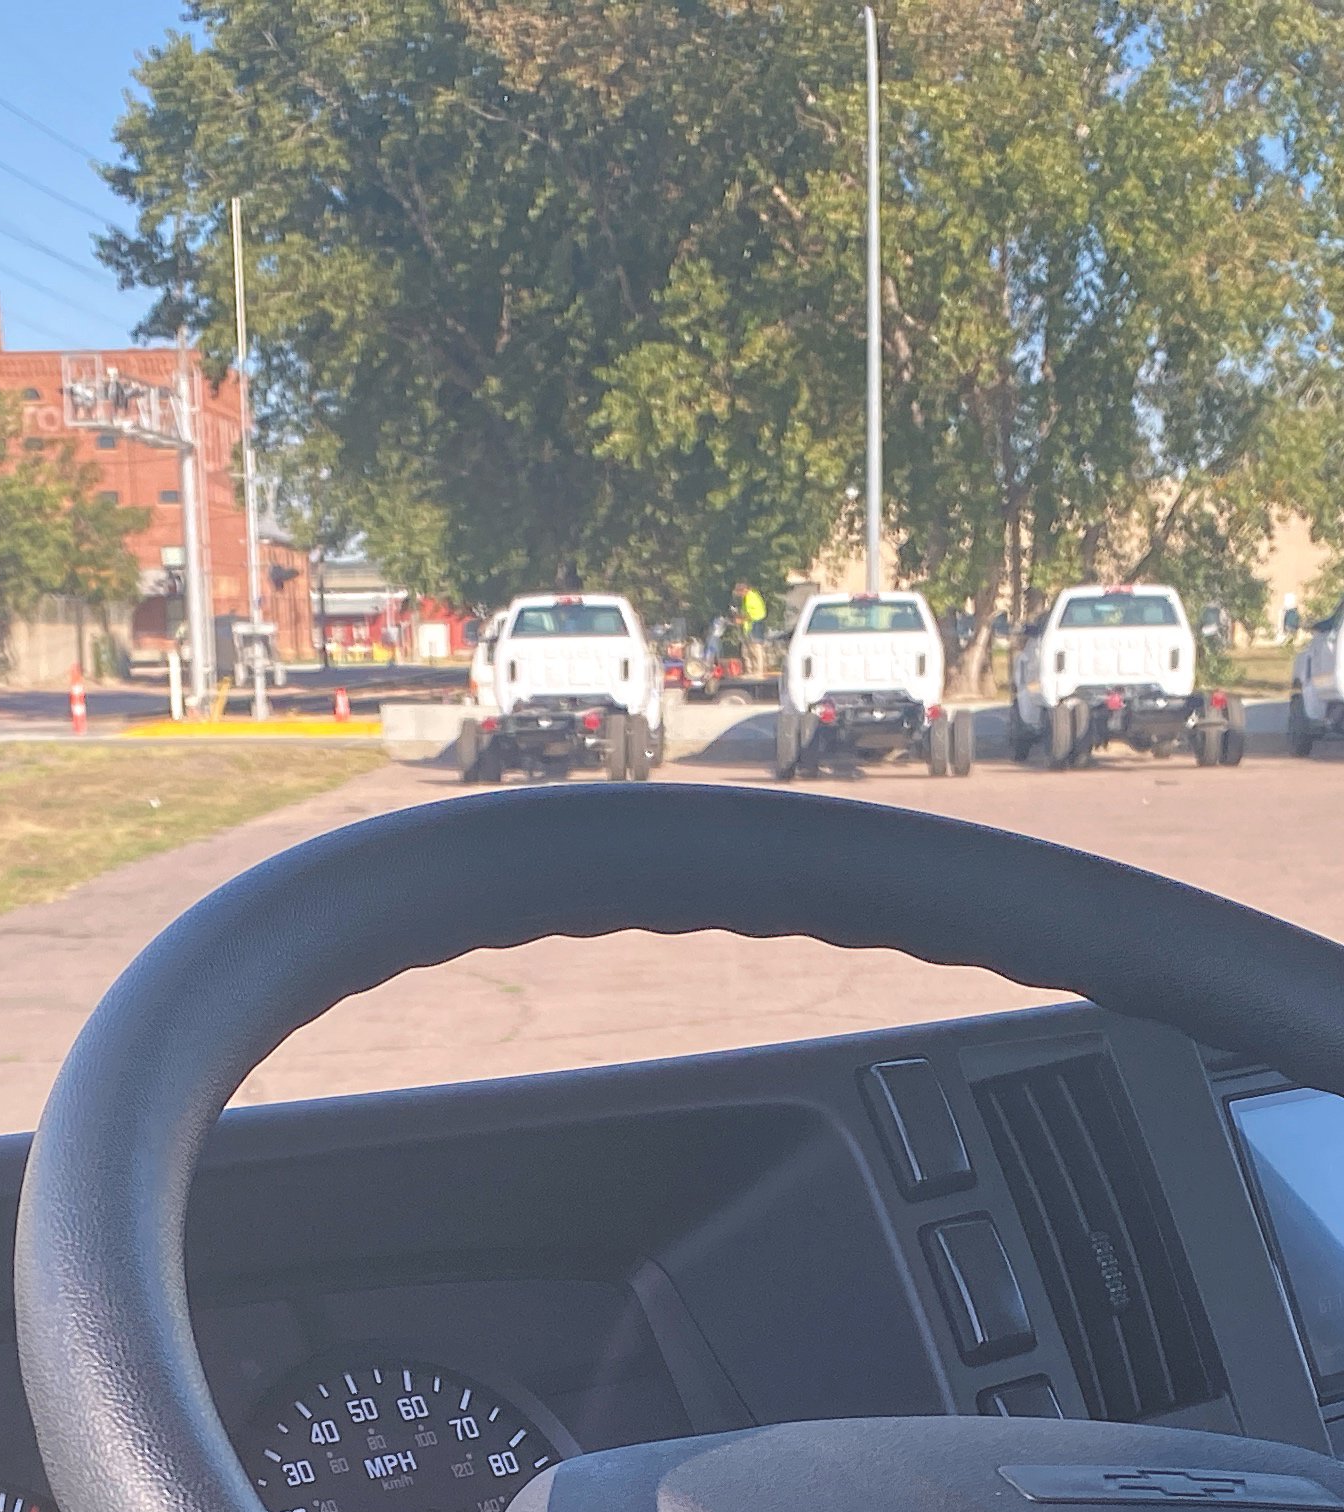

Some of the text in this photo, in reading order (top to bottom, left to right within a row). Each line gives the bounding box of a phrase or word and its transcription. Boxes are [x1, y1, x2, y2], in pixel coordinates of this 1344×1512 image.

[346, 1397, 379, 1424] 50
[397, 1395, 429, 1421] 60
[310, 1420, 341, 1445] 40
[414, 1431, 438, 1447] 100
[449, 1416, 480, 1441] 70
[367, 1434, 388, 1450] 80
[282, 1460, 316, 1487] 30
[329, 1457, 350, 1475] 60
[363, 1451, 418, 1480] MPH
[451, 1461, 475, 1479] 120
[487, 1451, 520, 1478] 80
[381, 1474, 415, 1492] km/h
